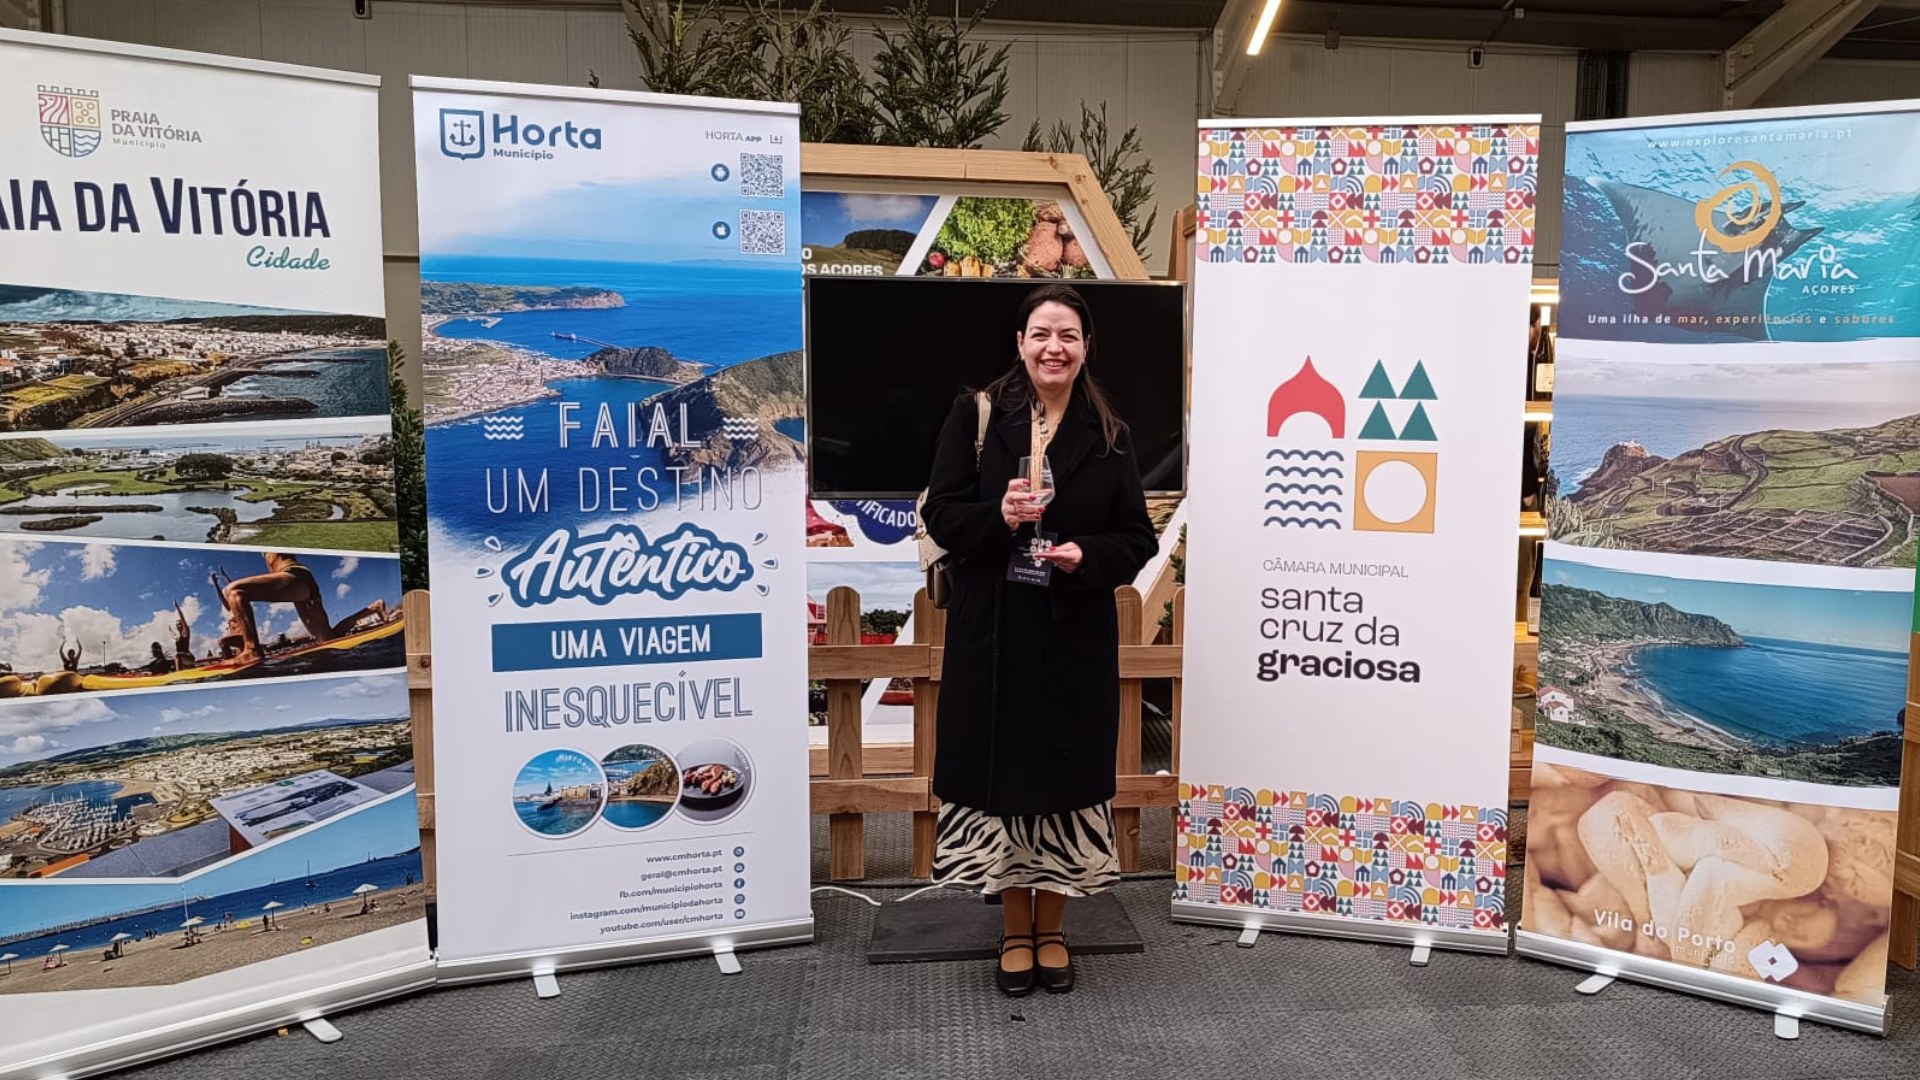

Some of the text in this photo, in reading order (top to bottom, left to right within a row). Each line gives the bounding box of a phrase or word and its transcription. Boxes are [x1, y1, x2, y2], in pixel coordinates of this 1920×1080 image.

[111, 108, 160, 126] PRAIA
[111, 122, 203, 143] DA VITÓRIA
[112, 137, 167, 150] Município
[493, 113, 602, 150] Horta
[705, 130, 762, 143] HORTA APP
[1647, 128, 1852, 149] www.exploresantamaria.pt
[493, 148, 554, 161] Município
[74, 181, 141, 233] DA
[150, 176, 331, 238] VITÓRIA
[246, 245, 331, 271] Cidade
[1618, 228, 1859, 294] Santa Maria
[1802, 284, 1856, 297] AÇORES
[1588, 314, 1617, 324] Uma
[1622, 313, 1649, 324] ilha
[1655, 314, 1672, 324] de
[1678, 315, 1709, 326] mar,
[1819, 315, 1827, 324] e
[559, 402, 702, 448] FAIAL
[486, 466, 763, 514] UM DESTINO
[509, 529, 747, 600] Autêntico
[1262, 557, 1409, 578] CÂMARA MUNICIPAL
[1261, 586, 1364, 614] santa
[551, 624, 711, 660] UMA VIAGEM
[1260, 616, 1400, 646] cruz da
[1257, 649, 1421, 683] graciosa
[505, 670, 754, 732] INESQUECÍVEL
[646, 849, 723, 863] www.cmhorta.pt
[640, 865, 723, 882] geral@cmhorta.pt
[619, 881, 723, 899] fb.com/municipiohorta
[570, 897, 724, 921] instagram.com/municipiodahorta
[600, 913, 724, 934] youtube.com/user/cmhorta
[1593, 908, 1737, 953] Vila do Porto
